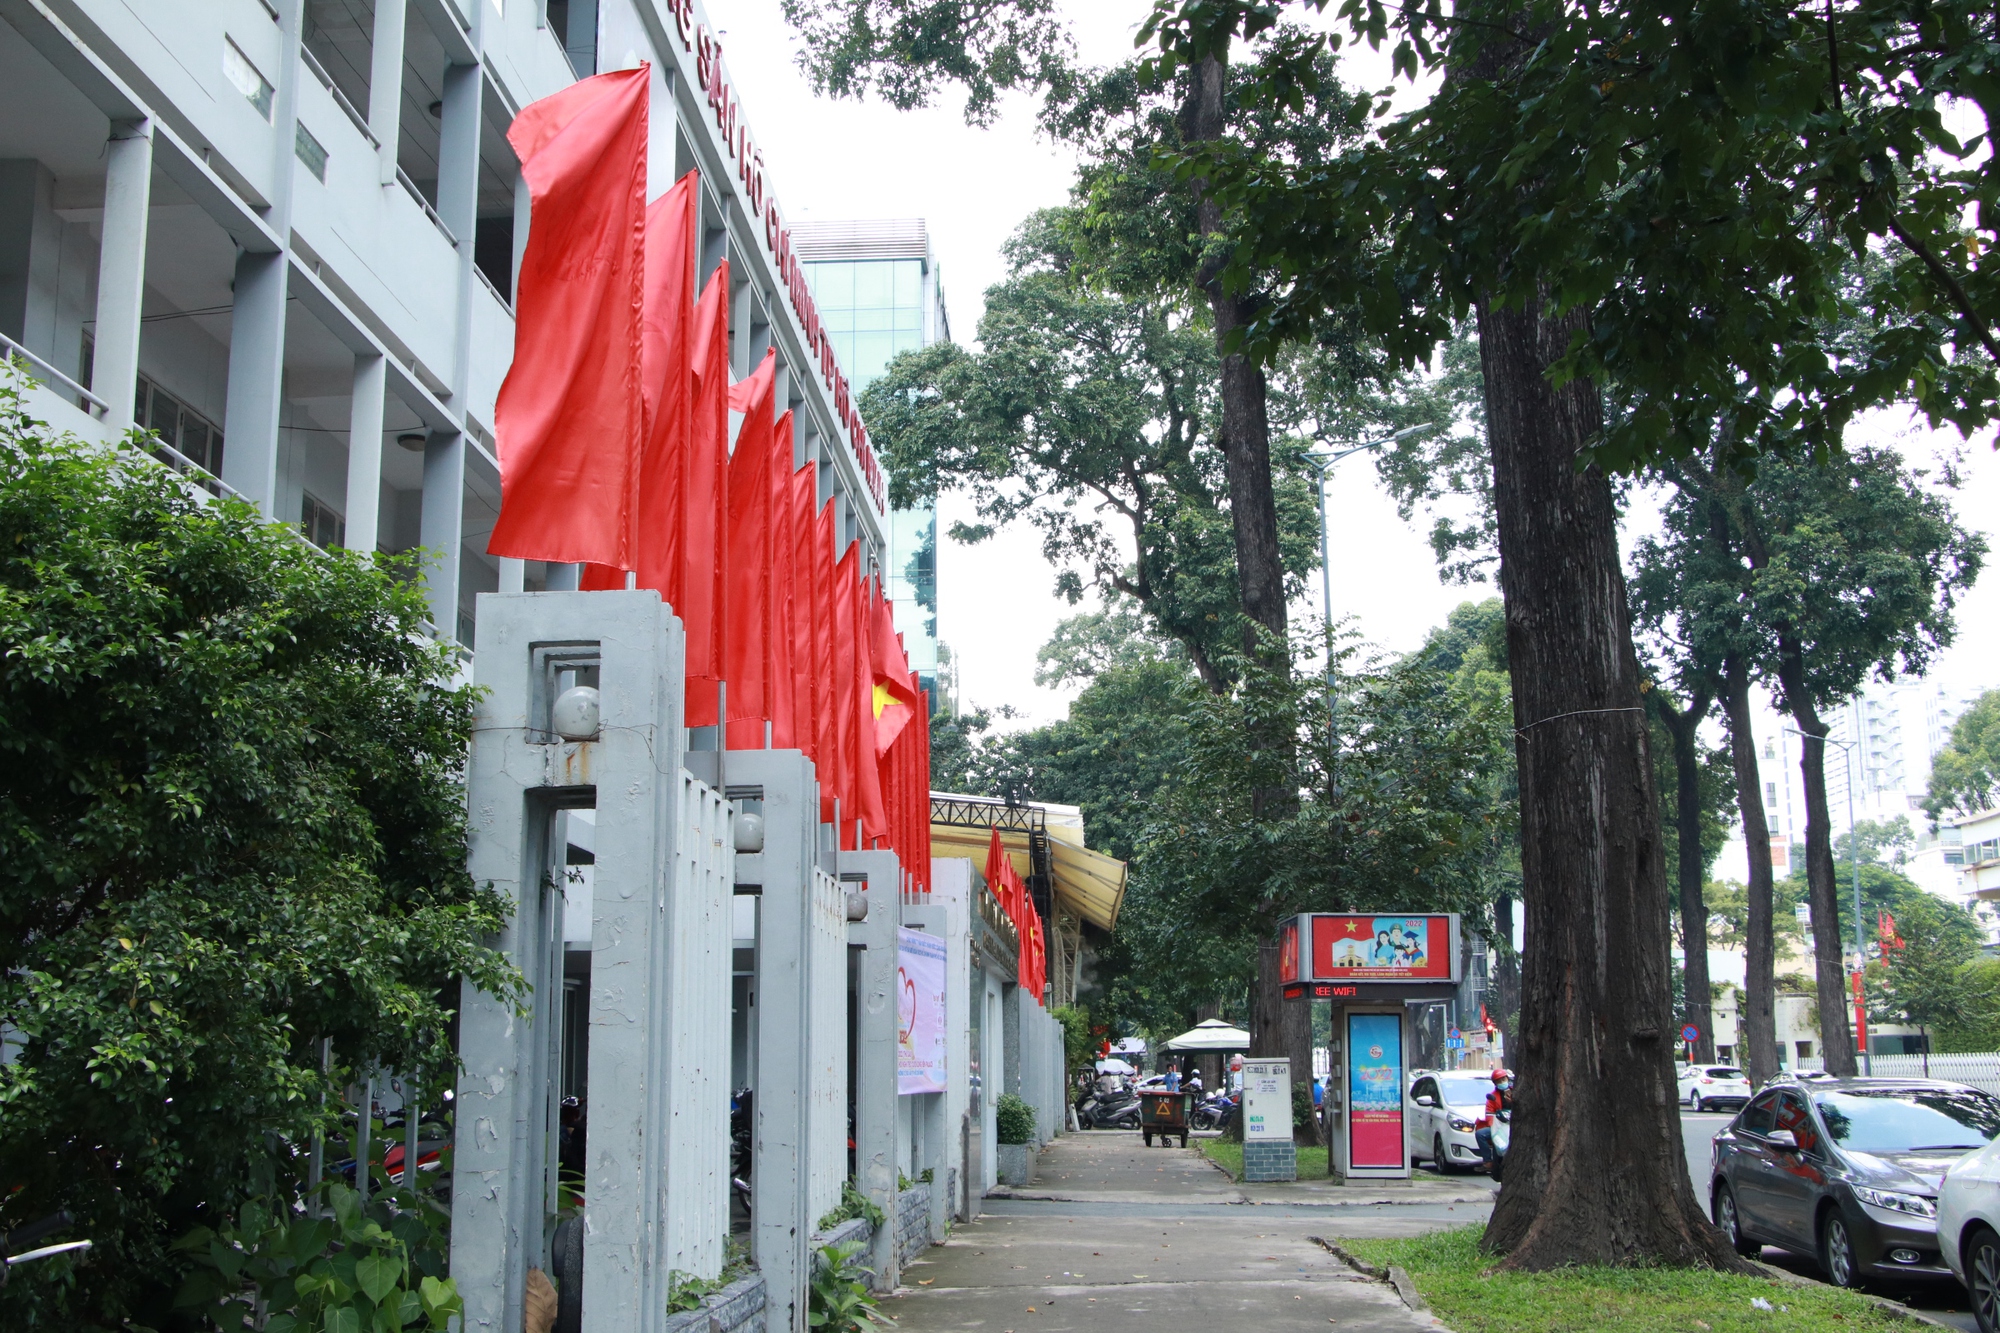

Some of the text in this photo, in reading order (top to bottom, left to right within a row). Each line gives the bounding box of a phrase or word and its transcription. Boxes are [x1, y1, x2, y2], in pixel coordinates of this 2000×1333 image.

[696, 23, 739, 159] SẢN
[739, 125, 765, 218] HỒ
[766, 196, 791, 286] CHÍ
[1405, 919, 1423, 927] 2022
[1360, 1067, 1394, 1081] 2022
